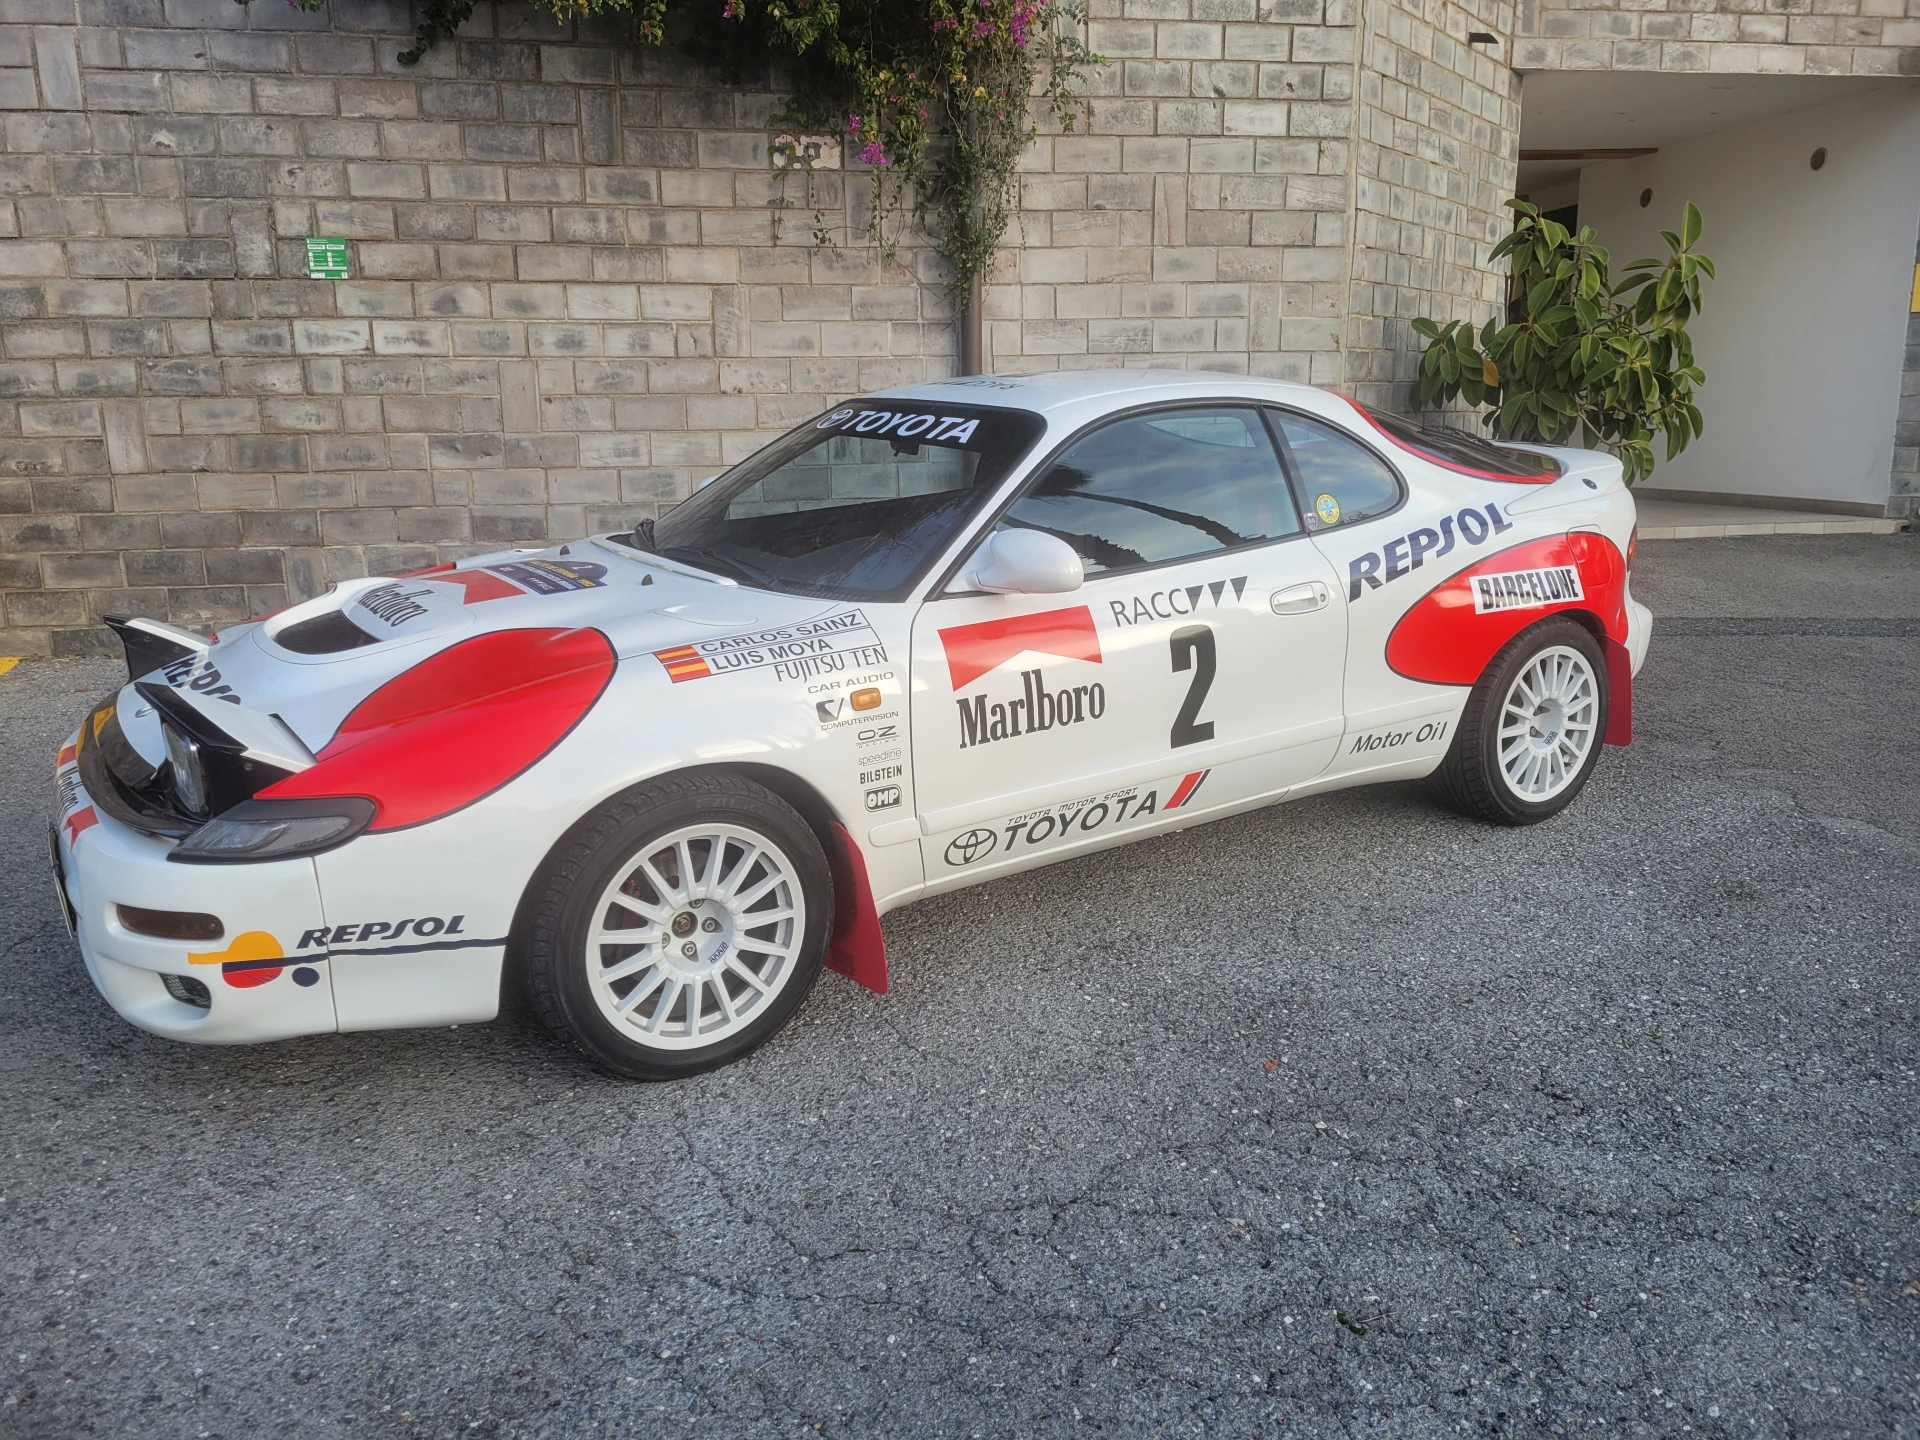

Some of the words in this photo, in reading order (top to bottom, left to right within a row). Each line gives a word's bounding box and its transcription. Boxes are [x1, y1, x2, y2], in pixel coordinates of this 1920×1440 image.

[840, 410, 980, 444] TOYOTA
[1349, 503, 1513, 604] REPSOL
[1477, 568, 1579, 610] BARCELONE
[1109, 588, 1190, 628] RACC
[700, 625, 794, 653] CARLOS
[796, 613, 863, 641] SAINZ
[711, 648, 764, 671] LUIS
[769, 638, 833, 661] MOYA
[773, 653, 845, 684] FUJITSU
[848, 645, 889, 668] TEN
[807, 681, 841, 694] CAR
[845, 671, 894, 687] AUDIO
[1169, 624, 1217, 749] 2
[820, 711, 899, 731] COMPUTERVISION
[955, 668, 1106, 750] Marlboro
[1349, 729, 1412, 755] Motor
[1415, 721, 1448, 743] Oil
[858, 748, 902, 766] speedline
[859, 764, 903, 785] BILSTEIN
[867, 788, 899, 808] OMP
[1007, 808, 1052, 826] TOYOTA
[1057, 797, 1097, 812] MOTOR
[1102, 787, 1138, 802] SPORT
[1004, 790, 1158, 852] TOYOTA
[296, 914, 466, 949] REPSOL
